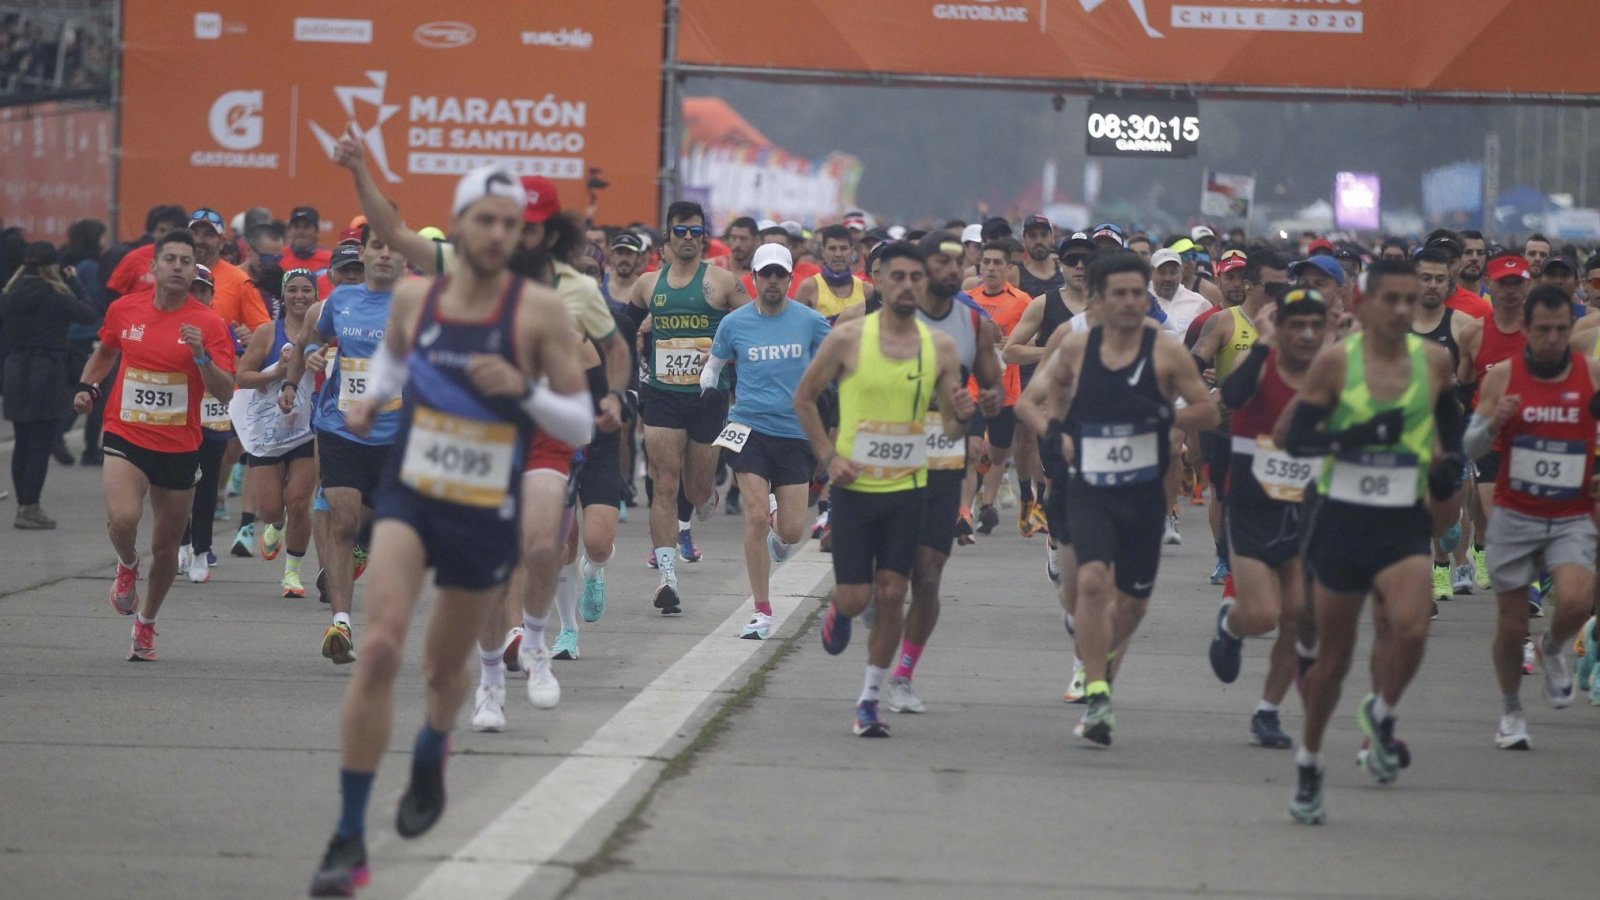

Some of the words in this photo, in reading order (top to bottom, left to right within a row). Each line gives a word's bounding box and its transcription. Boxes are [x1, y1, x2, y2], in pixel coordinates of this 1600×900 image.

[932, 4, 1028, 22] GATORADE
[1179, 10, 1266, 25] CHILE
[1288, 14, 1356, 28] 2020
[408, 93, 586, 128] MARATÓN
[1088, 113, 1200, 141] 08:30:15
[408, 127, 443, 147] DE
[450, 129, 584, 152] SANTIAGO
[1115, 139, 1172, 152] GARMIN
[654, 315, 709, 329] CRONOS
[342, 327, 362, 336] RUN
[665, 354, 701, 369] 2474
[748, 344, 802, 361] STRYD
[134, 389, 173, 406] 3931
[1522, 407, 1580, 423] CHILE
[867, 441, 914, 460] 2897
[1106, 446, 1133, 463] 40
[424, 445, 493, 477] 4095
[1264, 457, 1312, 480] 5399
[1535, 460, 1561, 478] 03
[1359, 475, 1390, 496] 08
